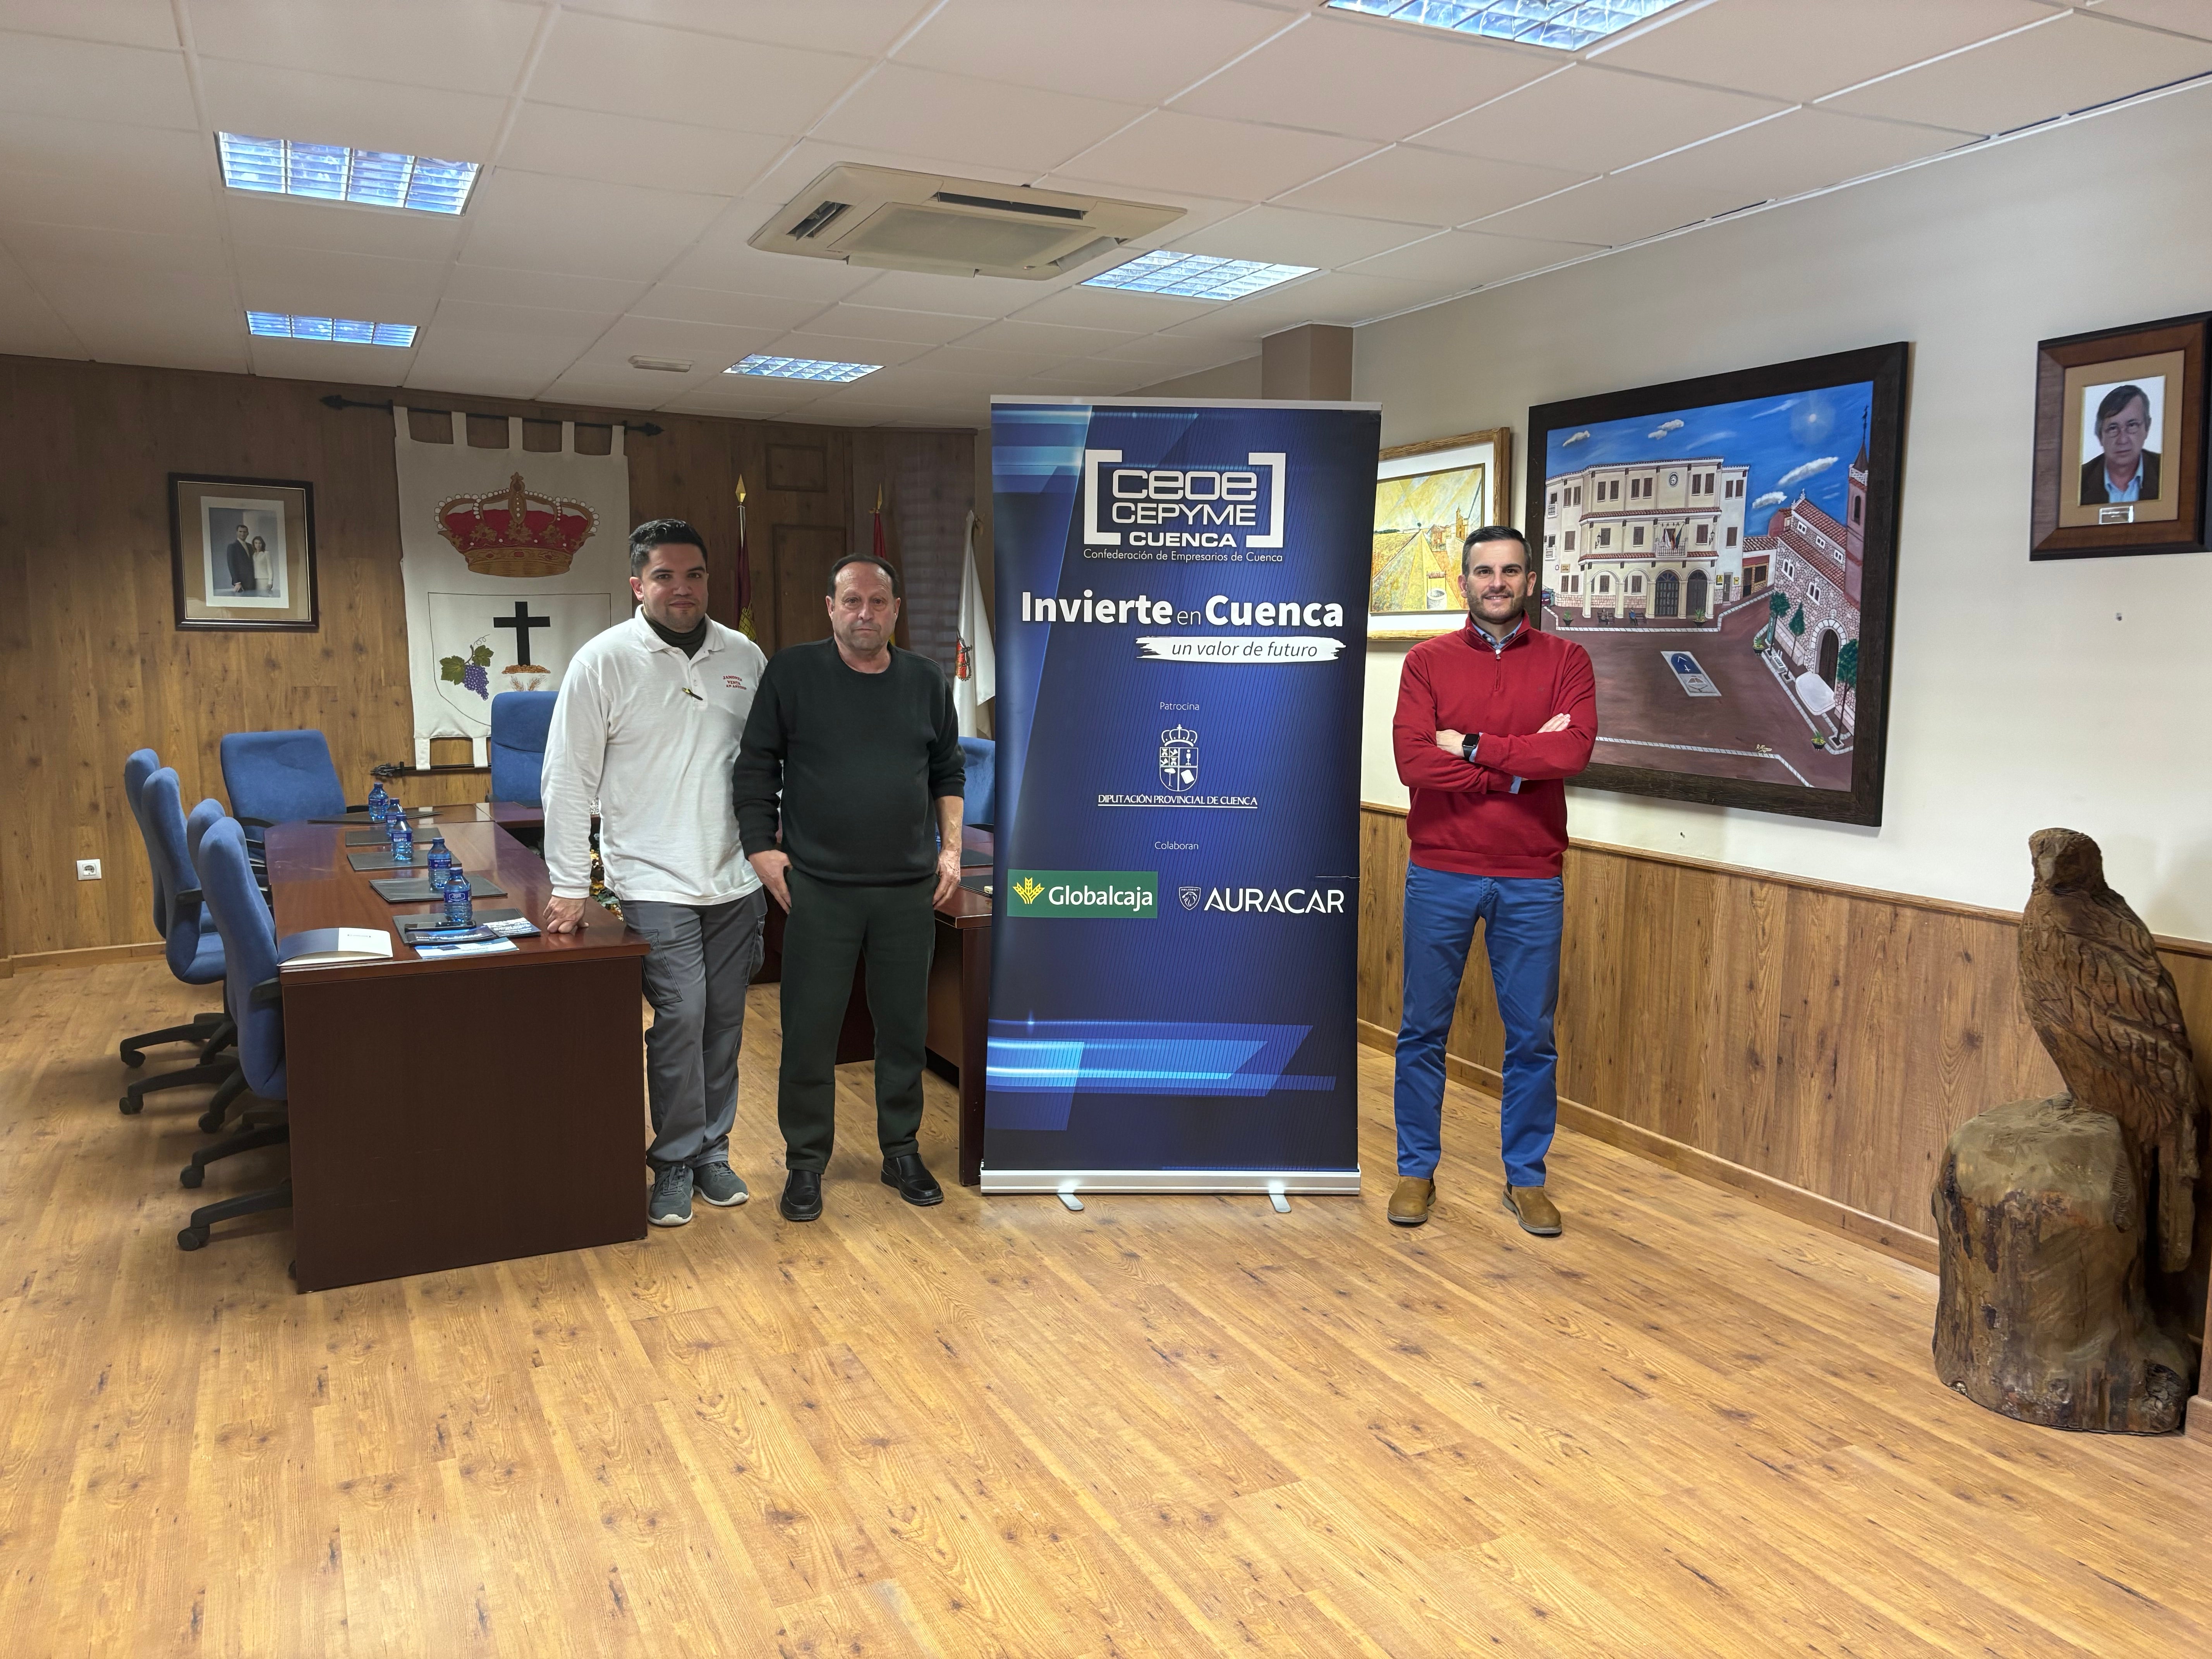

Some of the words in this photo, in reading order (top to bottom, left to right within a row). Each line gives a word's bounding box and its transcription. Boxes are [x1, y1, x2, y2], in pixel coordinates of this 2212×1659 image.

[1112, 469, 1257, 501] ceoe
[1112, 502, 1256, 526] CEPYME
[1129, 531, 1237, 548] CUENCA
[1084, 548, 1152, 560] Confederación
[1156, 550, 1168, 560] de
[1171, 551, 1228, 563] Empresarios
[1231, 551, 1243, 561] de
[1246, 552, 1283, 562] Cuenca
[1022, 589, 1173, 625] Invierte
[1177, 611, 1201, 625] en
[1205, 595, 1343, 627] Cuenca
[1172, 644, 1192, 655] un
[1197, 641, 1240, 656] valor
[1243, 641, 1263, 656] de
[1267, 641, 1317, 657] futuro
[1160, 702, 1199, 711] Patrocina
[1098, 793, 1152, 804] DIPUTACIÓN
[1154, 795, 1206, 805] PROVINCIAL
[1207, 796, 1219, 805] DE
[1220, 796, 1258, 806] CUENCA
[1154, 841, 1199, 850] Colaboran
[1048, 884, 1153, 912] Globalcaja
[1203, 887, 1344, 914] AURACAR
